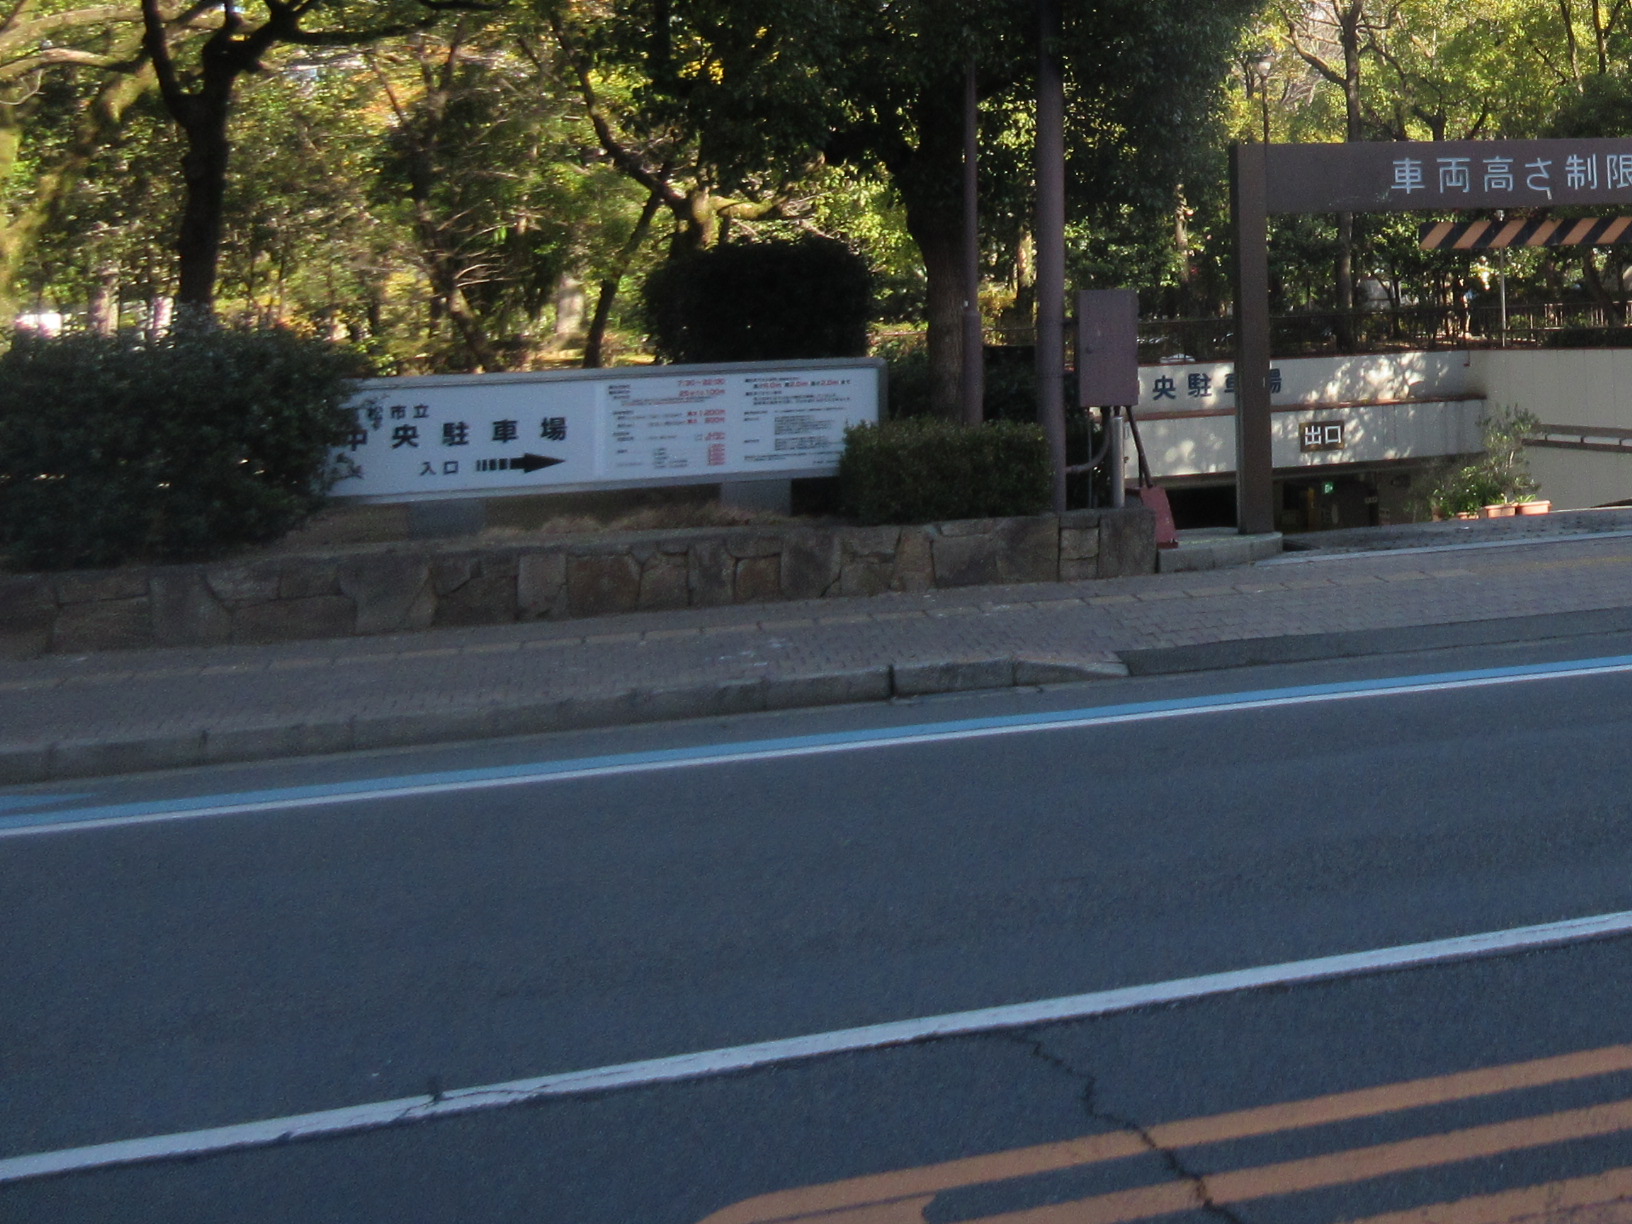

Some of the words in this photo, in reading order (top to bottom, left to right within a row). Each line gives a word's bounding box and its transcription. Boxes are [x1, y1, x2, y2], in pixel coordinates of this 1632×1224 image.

[367, 404, 430, 419] 松市立
[1304, 425, 1343, 445] 出口
[420, 460, 460, 476] 入口
